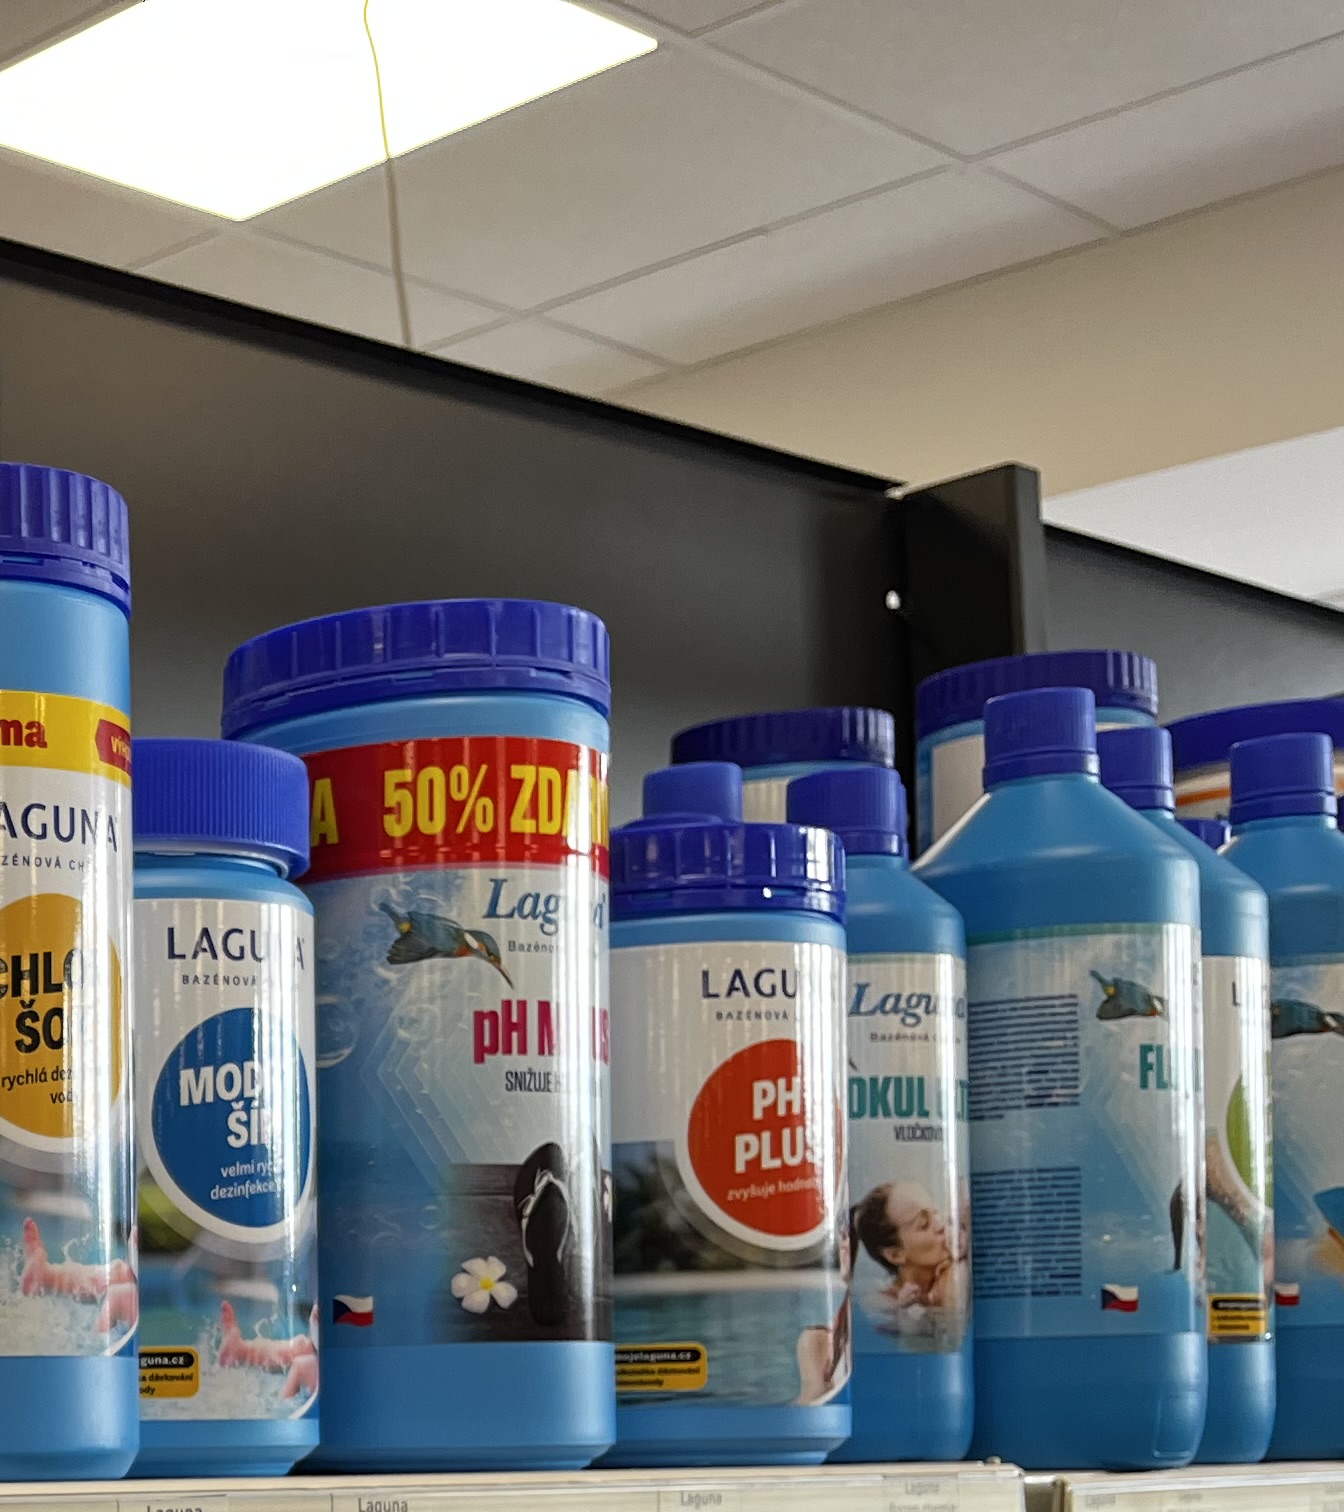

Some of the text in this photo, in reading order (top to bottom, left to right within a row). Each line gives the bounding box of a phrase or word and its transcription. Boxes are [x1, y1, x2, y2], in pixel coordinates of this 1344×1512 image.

[382, 763, 495, 838] 50%
[472, 998, 528, 1064] pH
[1, 1067, 48, 1091] rychlá
[220, 1160, 254, 1178] velmi
[727, 1181, 778, 1203] zvyšuje
